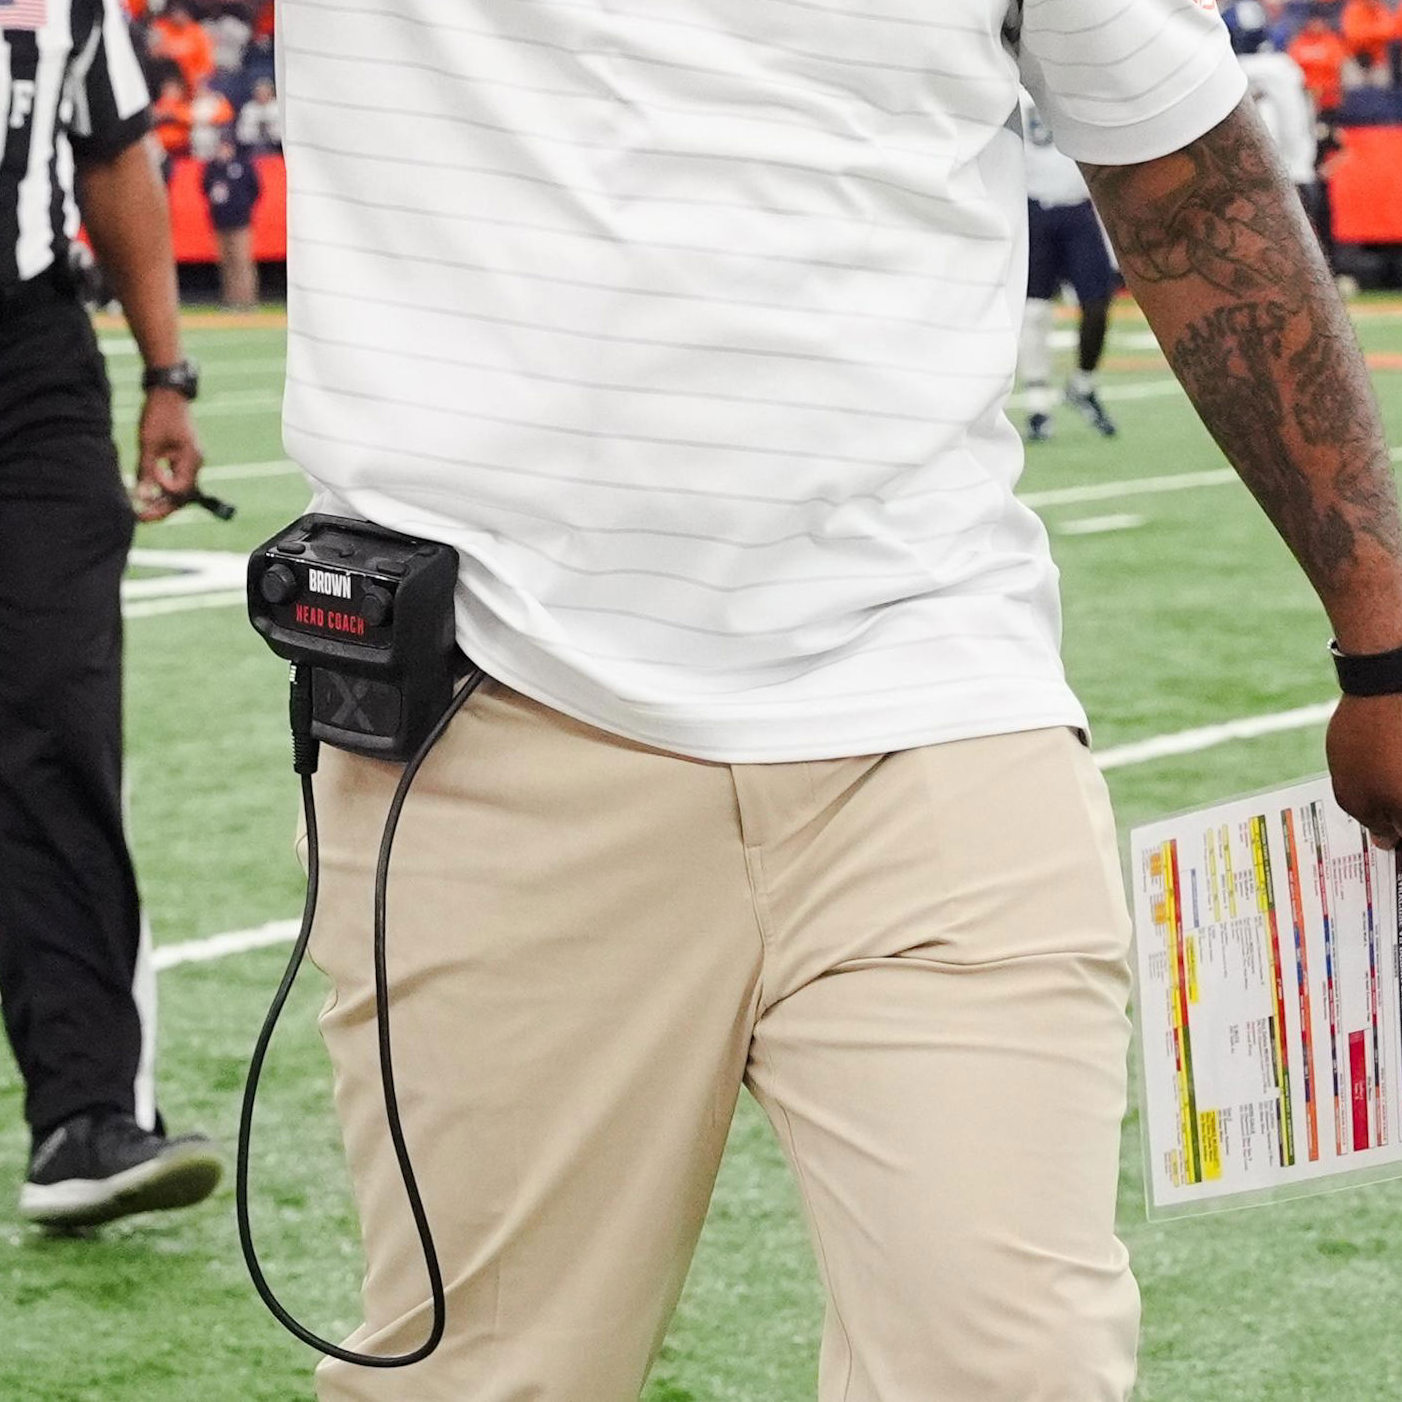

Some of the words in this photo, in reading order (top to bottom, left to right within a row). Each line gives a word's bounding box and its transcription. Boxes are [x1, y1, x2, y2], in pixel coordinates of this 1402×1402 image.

[309, 568, 351, 599] BROWN
[296, 604, 324, 627] HEAD
[327, 612, 364, 635] COACH
